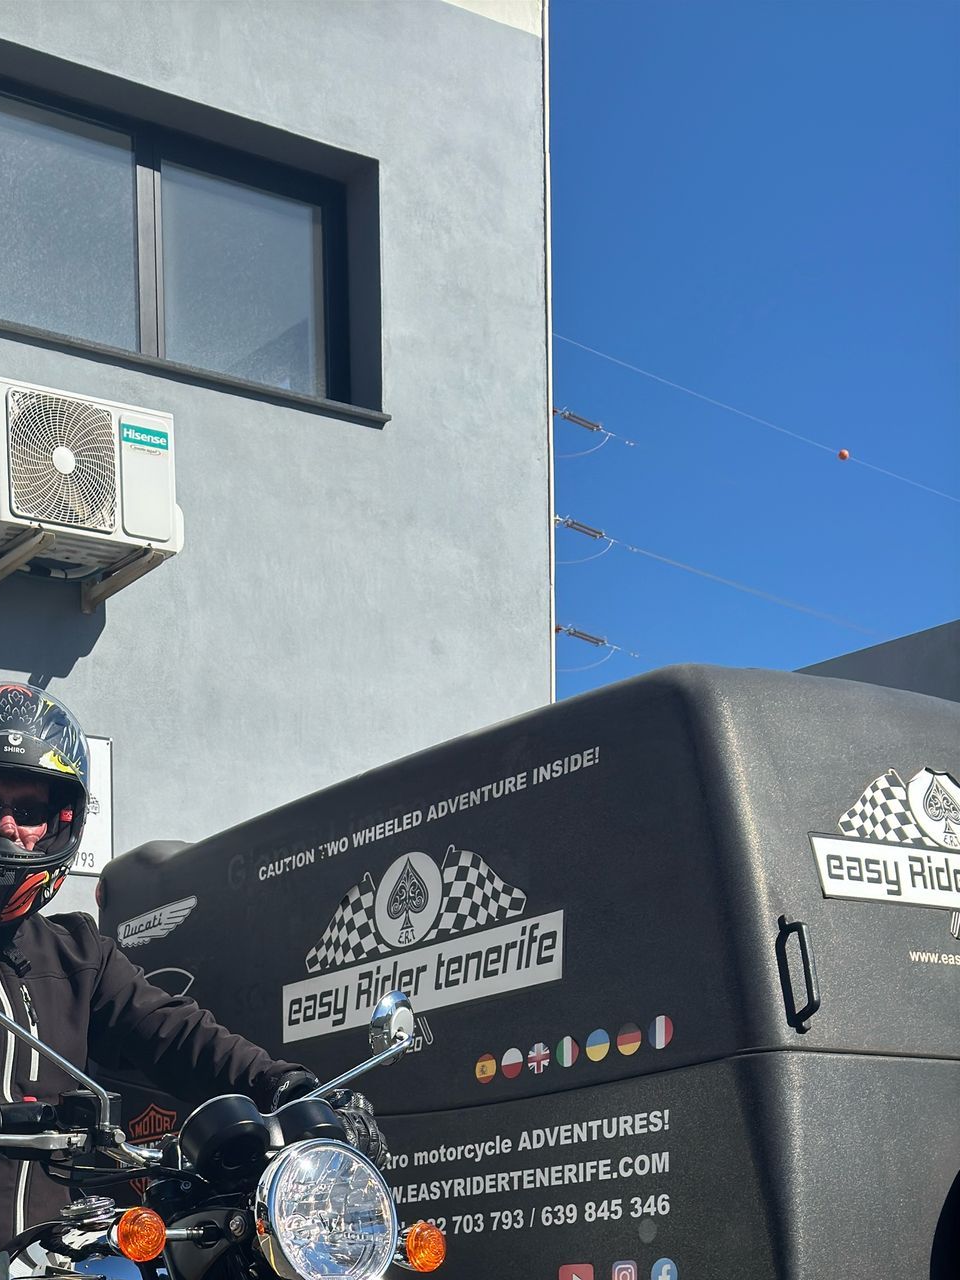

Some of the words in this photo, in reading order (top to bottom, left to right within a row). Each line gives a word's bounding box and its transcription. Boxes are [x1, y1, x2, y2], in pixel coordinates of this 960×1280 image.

[123, 428, 167, 446] Hisense
[3, 746, 25, 754] SHIRO
[258, 849, 315, 881] CAUTION
[352, 810, 423, 848] WHEELED
[427, 772, 527, 823] ADVENTURE
[532, 746, 601, 785] INSIDE!
[826, 854, 902, 896] easy
[123, 913, 162, 939] Ducati
[287, 985, 349, 1027] easy
[355, 961, 428, 1010] Rider
[434, 922, 558, 991] tenerife
[135, 1114, 172, 1134] MOTOR
[414, 1135, 512, 1167] motorcycle
[518, 1109, 670, 1151] ADVENTURES!
[452, 1213, 485, 1235] 703
[490, 1209, 524, 1231] 793
[541, 1203, 578, 1226] 639
[584, 1199, 623, 1222] 845
[630, 1194, 671, 1217] 346
